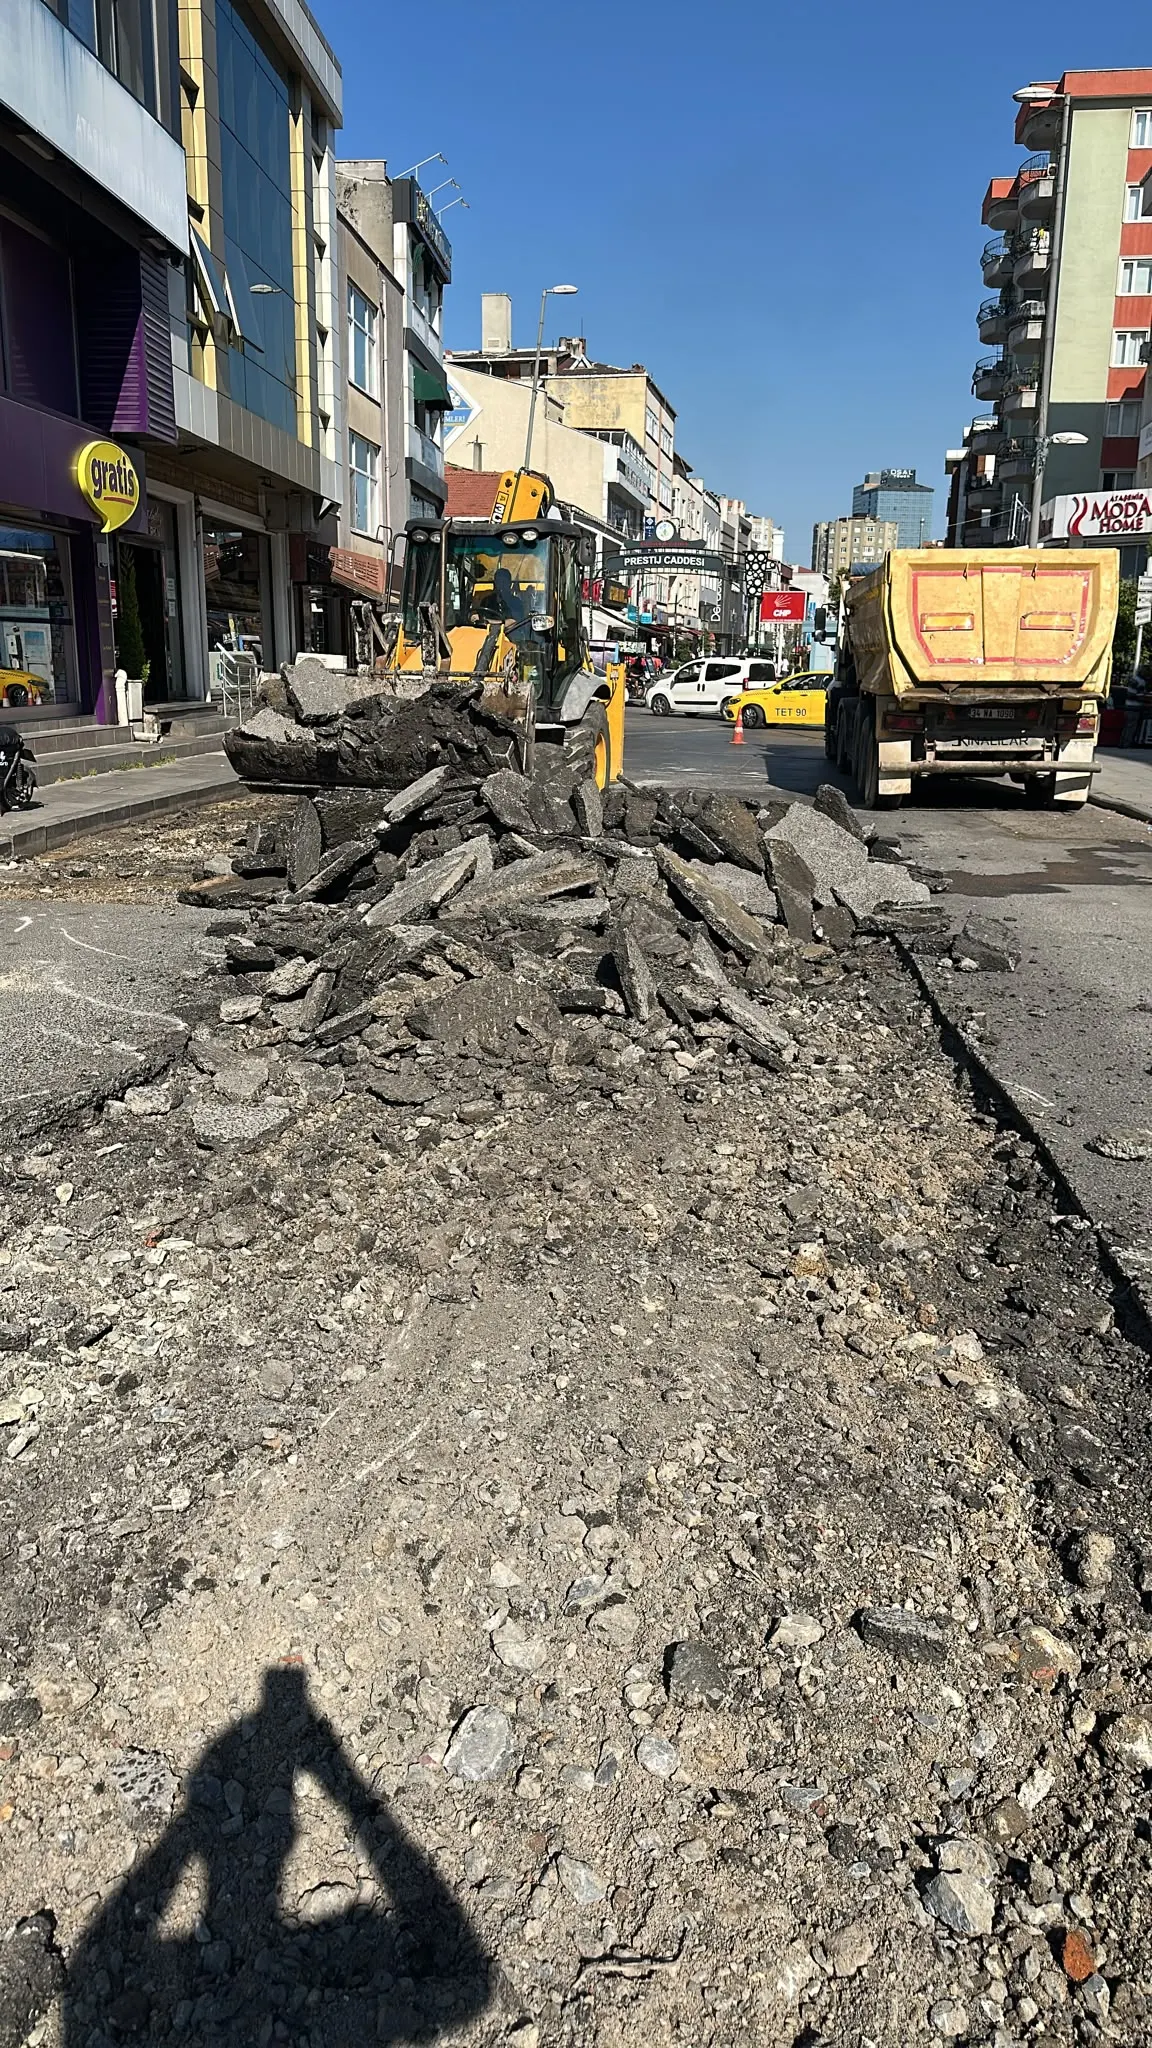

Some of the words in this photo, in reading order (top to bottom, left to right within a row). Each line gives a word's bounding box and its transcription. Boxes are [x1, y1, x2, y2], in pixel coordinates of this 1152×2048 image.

[91, 456, 135, 499] gratis
[490, 503, 505, 525] CB
[1090, 497, 1152, 521] MODA
[1099, 518, 1144, 533] HOME
[773, 609, 792, 617] CHP
[775, 707, 793, 717] TET
[796, 708, 807, 717] 90
